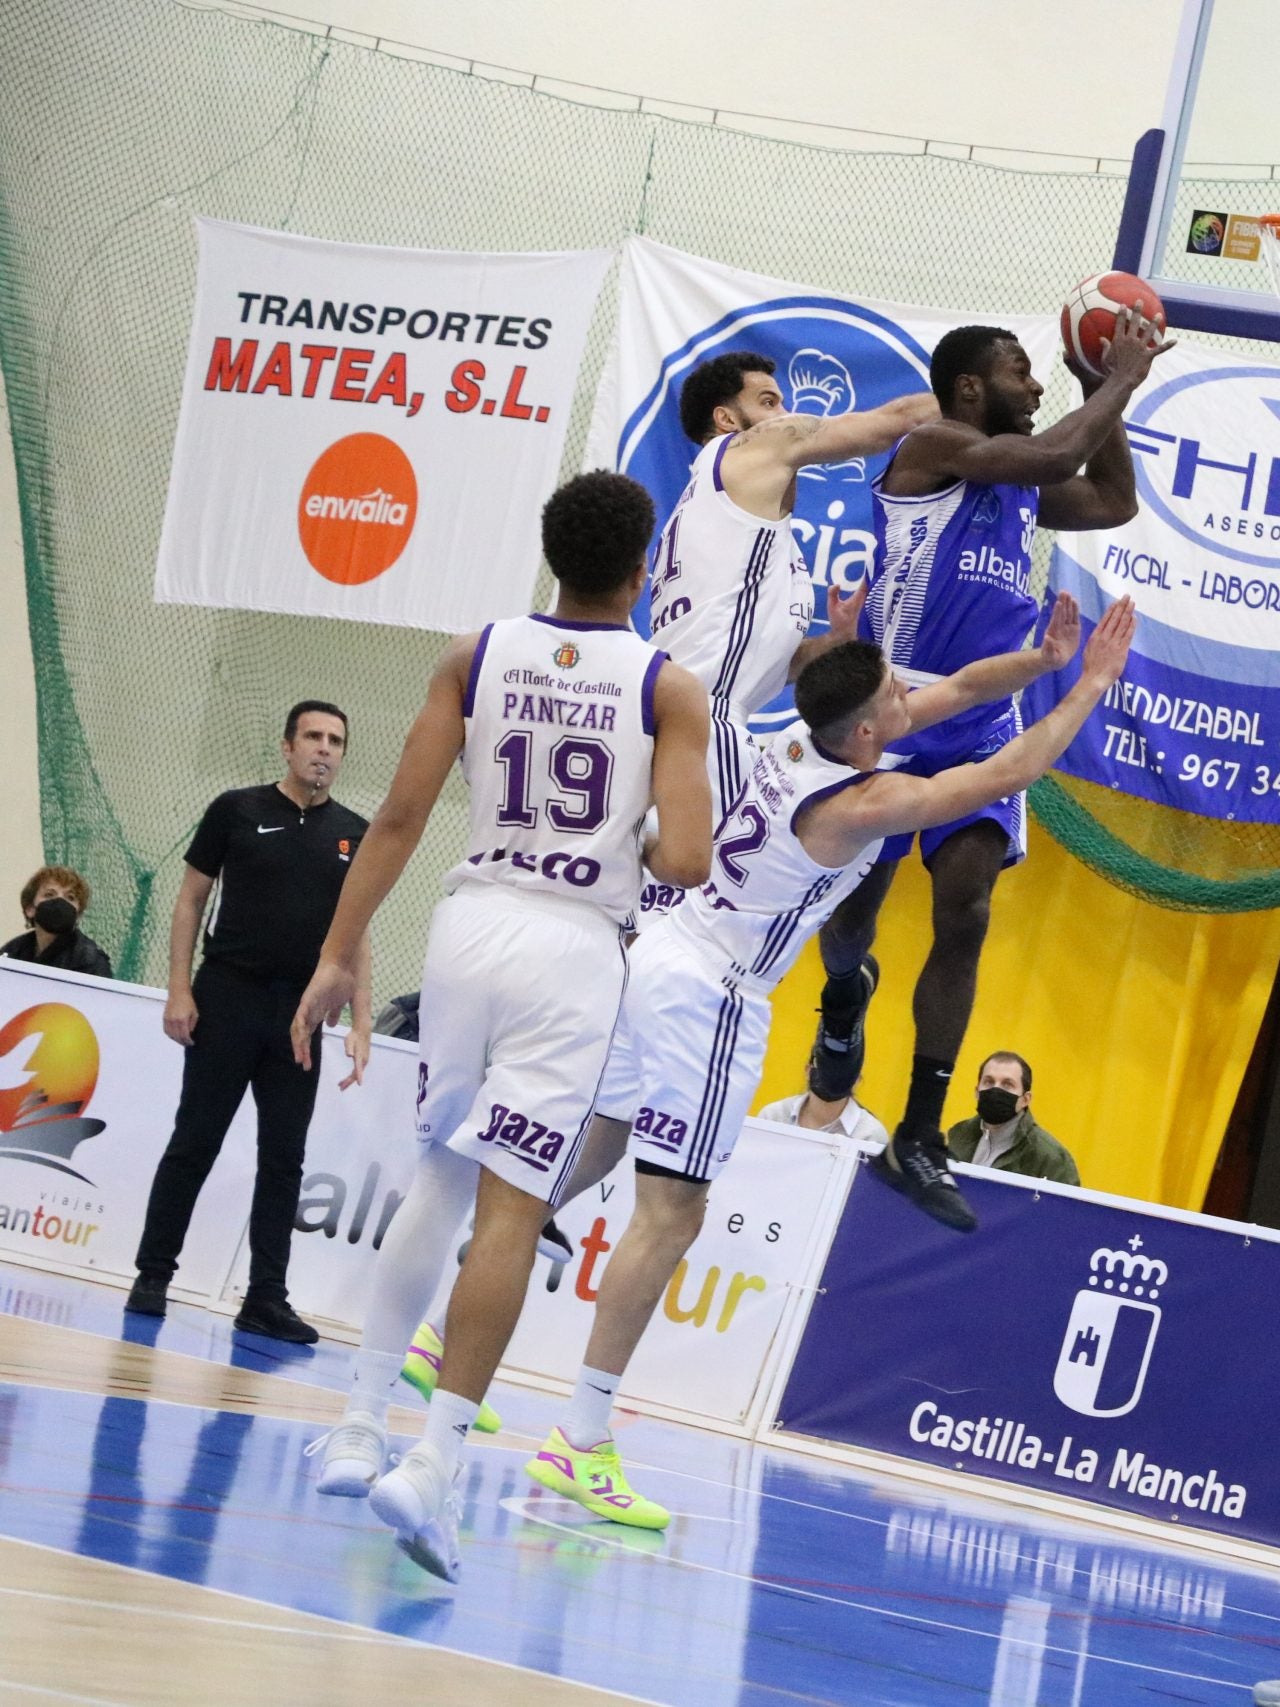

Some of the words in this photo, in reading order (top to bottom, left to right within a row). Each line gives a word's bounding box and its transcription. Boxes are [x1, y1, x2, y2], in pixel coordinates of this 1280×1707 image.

[238, 291, 553, 350] TRANSPORTES
[204, 337, 425, 418] MATEA,
[445, 358, 551, 424] S.L.
[1102, 544, 1173, 592] FISCAL
[523, 670, 555, 689] Norte
[557, 677, 571, 692] de
[573, 680, 622, 697] Castilla
[502, 692, 616, 731] PANTZAR
[494, 729, 615, 835] 19
[1178, 753, 1241, 792] 967
[477, 1103, 565, 1164] gaza
[634, 1106, 688, 1146] aza
[40, 1191, 105, 1214] viajes
[909, 1401, 1098, 1483] Castilla-La
[1108, 1448, 1247, 1519] Mancha
